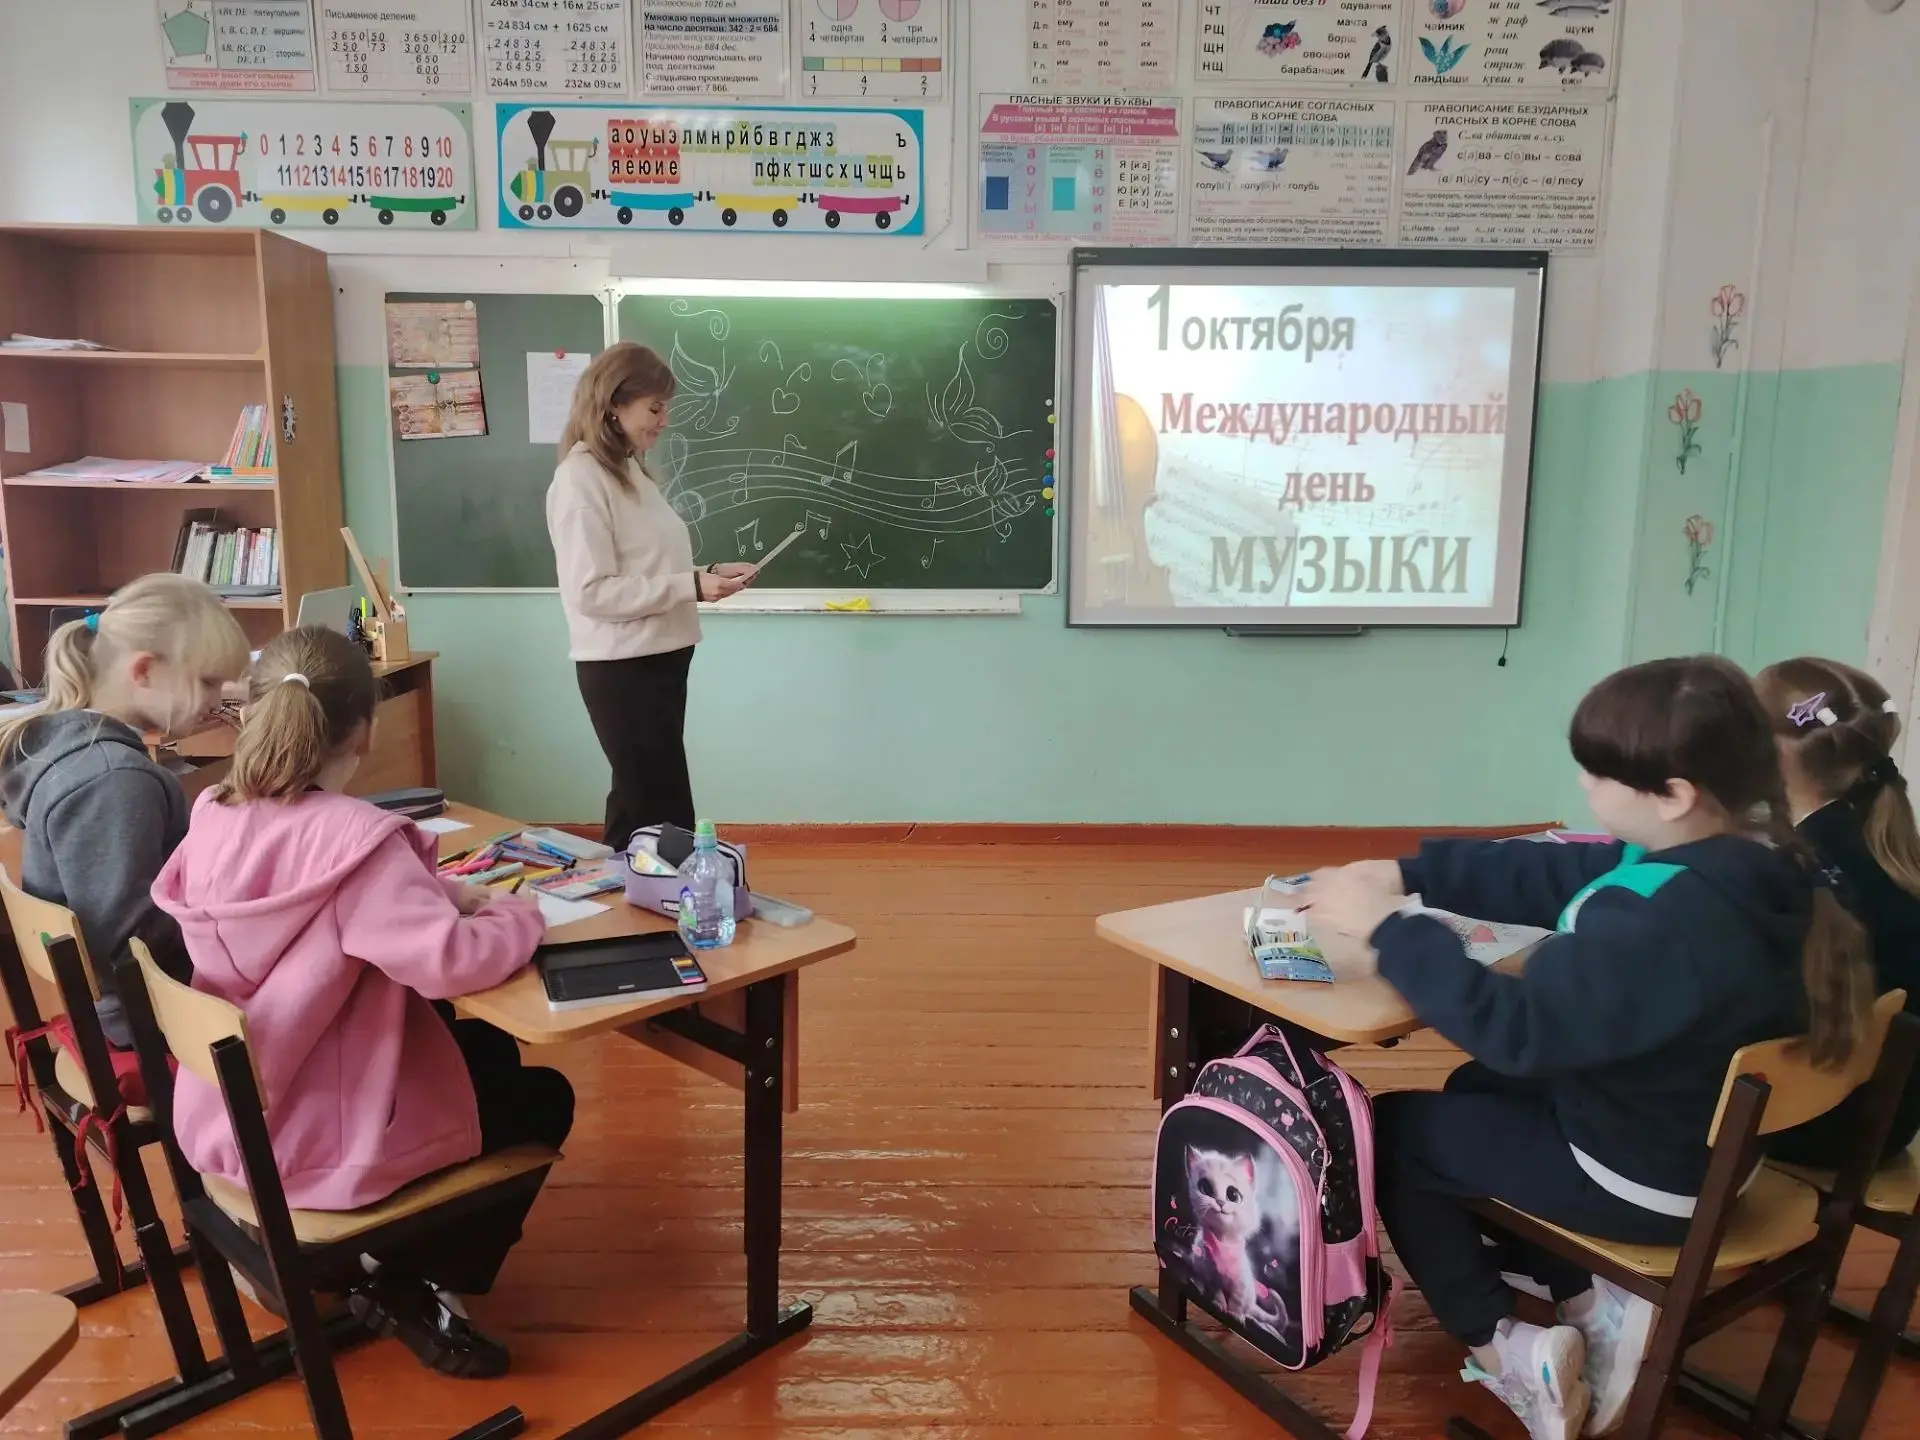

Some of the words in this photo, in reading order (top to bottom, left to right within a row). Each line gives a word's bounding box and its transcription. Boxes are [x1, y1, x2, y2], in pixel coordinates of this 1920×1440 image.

[325, 10, 377, 20] Письменное
[380, 12, 415, 21] деление
[644, 13, 687, 22] Умножаю
[690, 15, 725, 23] первый
[831, 25, 852, 33] одна
[1424, 22, 1465, 31] чайник
[1566, 26, 1594, 34] щуки
[1303, 50, 1350, 59] овощной
[1281, 66, 1345, 75] барабанщик
[1010, 96, 1062, 104] ГЛАСНЫЕ
[1067, 96, 1100, 105] ЗВУКИ
[1104, 97, 1111, 105] И
[1114, 98, 1152, 106] БУКВЫ
[1215, 100, 1303, 109] ПРАВОПИСАНИЕ
[1308, 102, 1374, 111] СОГЛАСНЫХ
[1425, 104, 1514, 113] ПРАВОПИСАНИЕ
[1518, 105, 1589, 116] БЕЗУДАРНЫХ
[1251, 113, 1258, 121] В
[1262, 113, 1298, 121] КОРНЕ
[1301, 113, 1338, 122] СЛОВА
[1435, 117, 1488, 125] ГЛАСНЫХ
[1492, 117, 1499, 125] В
[1503, 117, 1537, 126] КОРНЕ
[1541, 118, 1576, 127] СЛОВА
[260, 134, 268, 156] 0
[279, 134, 287, 156] 1
[296, 134, 304, 156] 2
[314, 135, 322, 156] 3
[331, 136, 340, 156] 4
[350, 136, 358, 157] 5
[369, 136, 377, 157] 6
[386, 136, 393, 157] 7
[404, 136, 413, 157] 8
[421, 137, 429, 157] 9
[436, 137, 452, 157] 10
[277, 166, 292, 186] 11
[294, 166, 310, 186] 12
[312, 166, 328, 187] 13
[330, 166, 346, 187] 14
[348, 166, 364, 187] 15
[366, 166, 382, 187] 16
[384, 167, 399, 187] 17
[402, 167, 418, 188] 18
[419, 167, 435, 188] 19
[437, 168, 453, 188] 20
[1147, 284, 1173, 352] 1
[1182, 304, 1355, 363] октября
[1160, 392, 1508, 445] Международный
[1279, 471, 1375, 510] день
[1210, 535, 1472, 594] МУЗЫКИ
